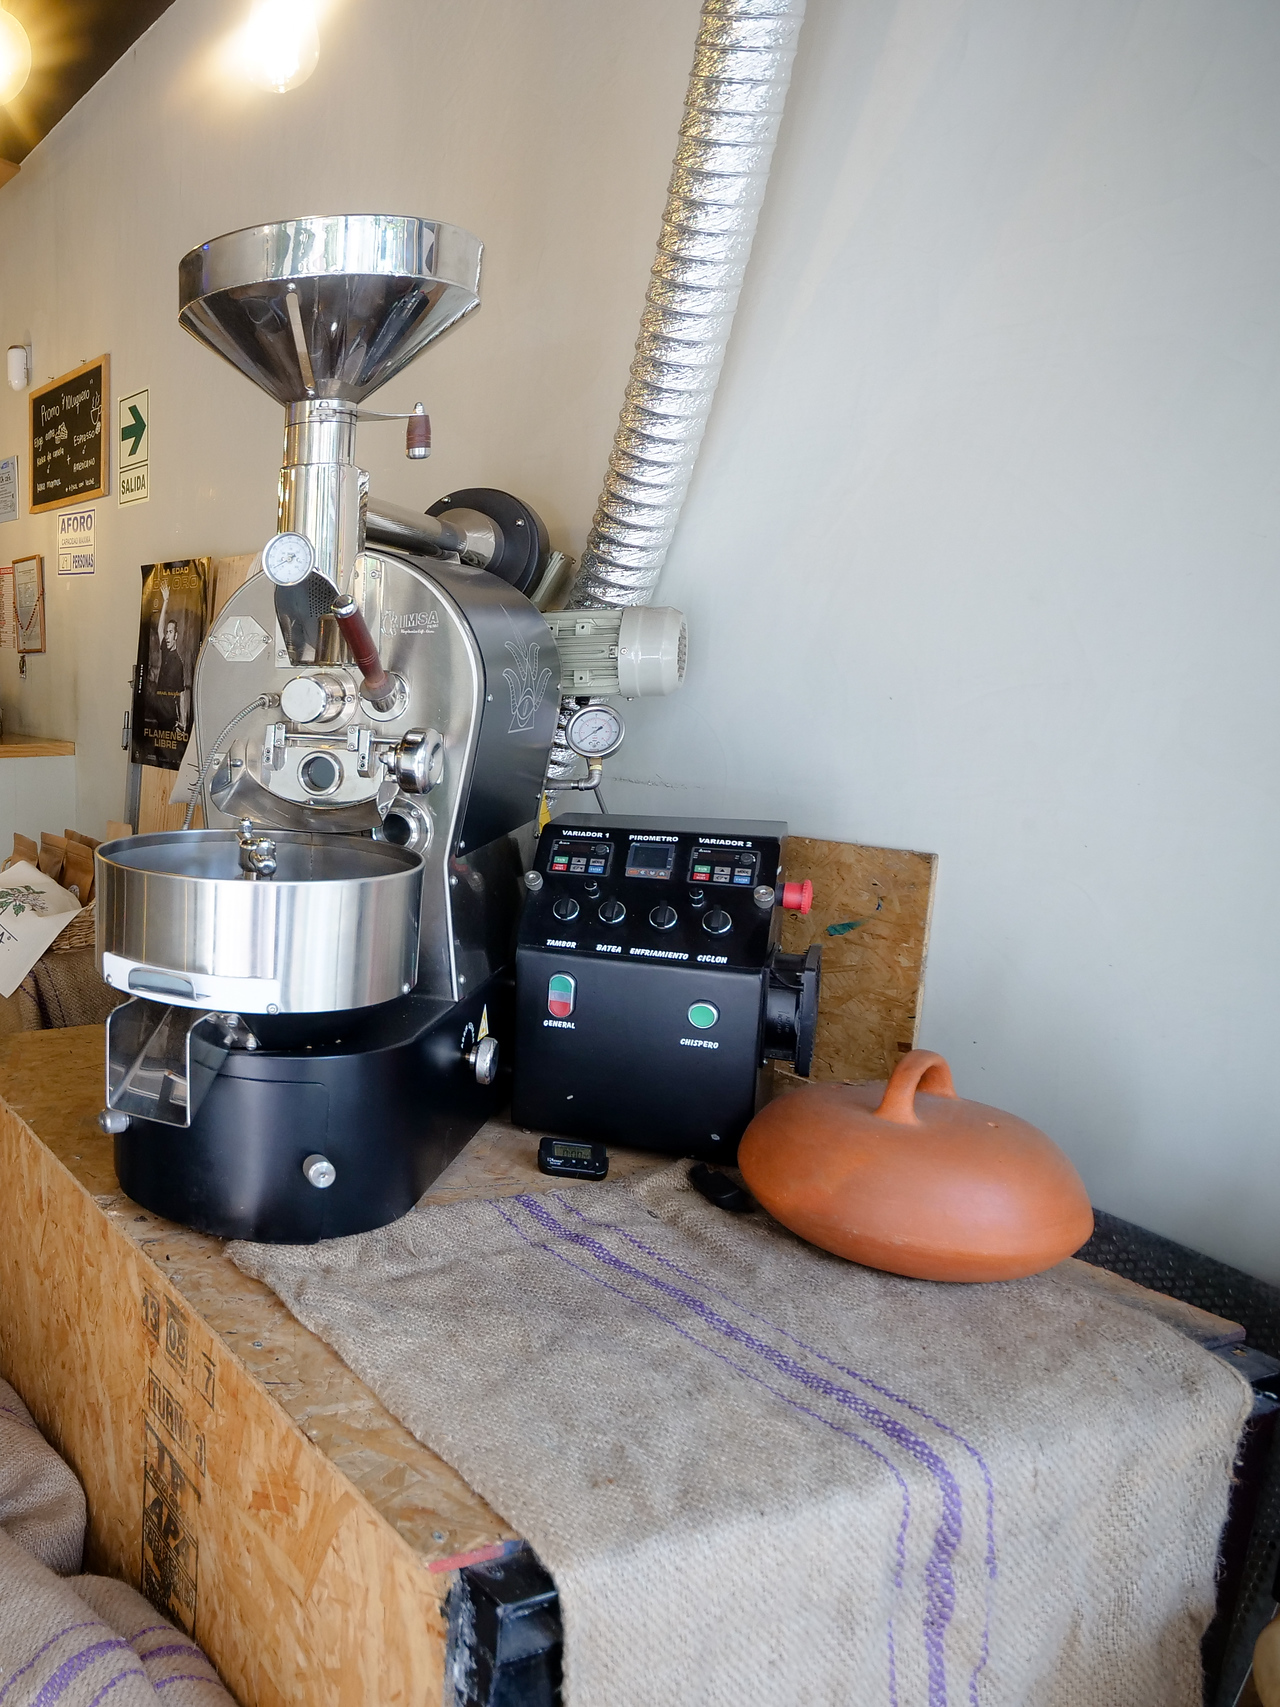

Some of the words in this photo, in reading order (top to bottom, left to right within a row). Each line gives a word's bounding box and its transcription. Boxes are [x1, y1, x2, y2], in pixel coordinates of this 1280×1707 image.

[121, 474, 146, 495] SALIDA
[60, 514, 93, 534] AFORO
[72, 553, 94, 569] PERSONAS
[162, 568, 171, 576] LA
[172, 566, 189, 575] EDAD
[172, 574, 199, 590] ORO
[400, 610, 439, 629] IMSA
[143, 728, 189, 742] FLAMENCO
[154, 738, 178, 750] LIBRE
[562, 830, 603, 838] VARIADOR
[629, 834, 679, 842] PIROMETRO
[699, 837, 744, 847] VARIADOR
[546, 939, 577, 949] TAMBOR
[596, 944, 622, 953] BATEA
[629, 948, 689, 960] ENFRIAMIENTO
[696, 954, 728, 964] CICLON
[543, 1019, 576, 1029] GENERAL
[680, 1038, 719, 1049] CHISPERO
